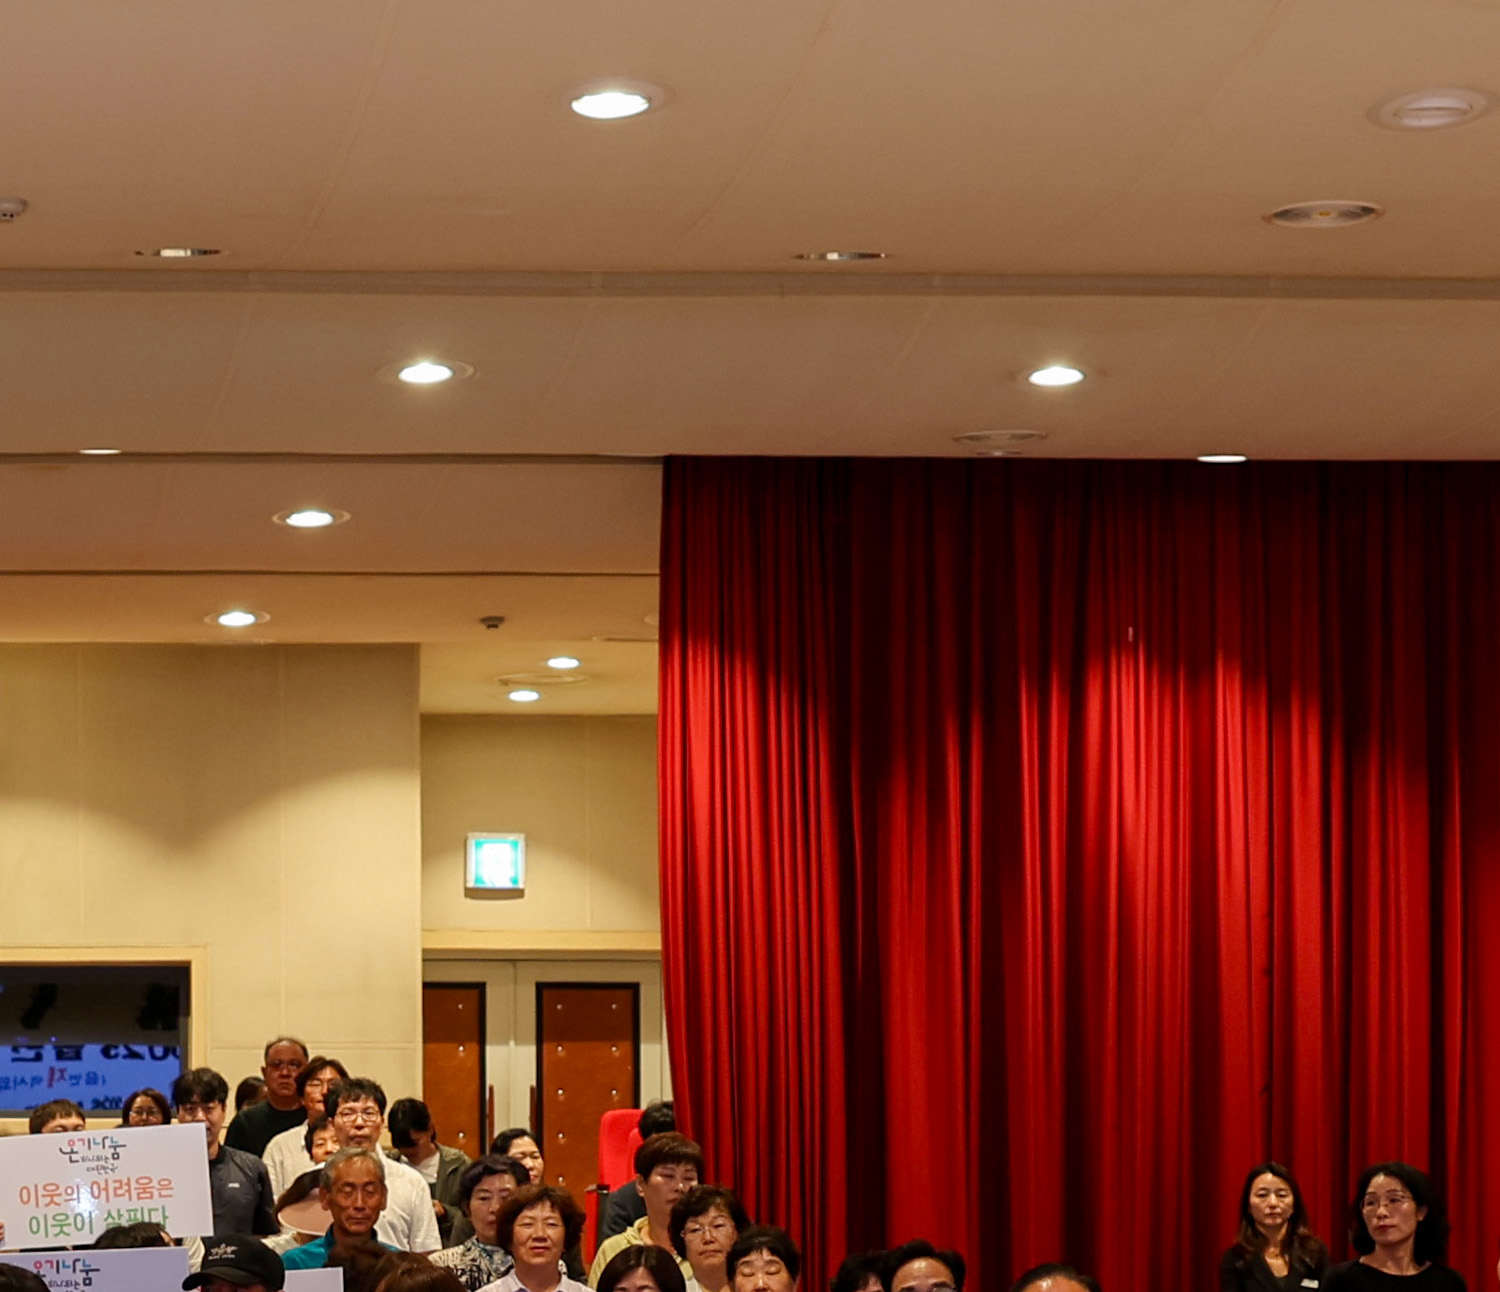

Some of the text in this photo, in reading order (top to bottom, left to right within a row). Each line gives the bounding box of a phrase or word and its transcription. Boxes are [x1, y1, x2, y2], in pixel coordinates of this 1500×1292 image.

[59, 1136, 127, 1163] 온기나눔
[19, 1176, 174, 1208] 이웃의 어려움은
[29, 1211, 94, 1238] 이웃이
